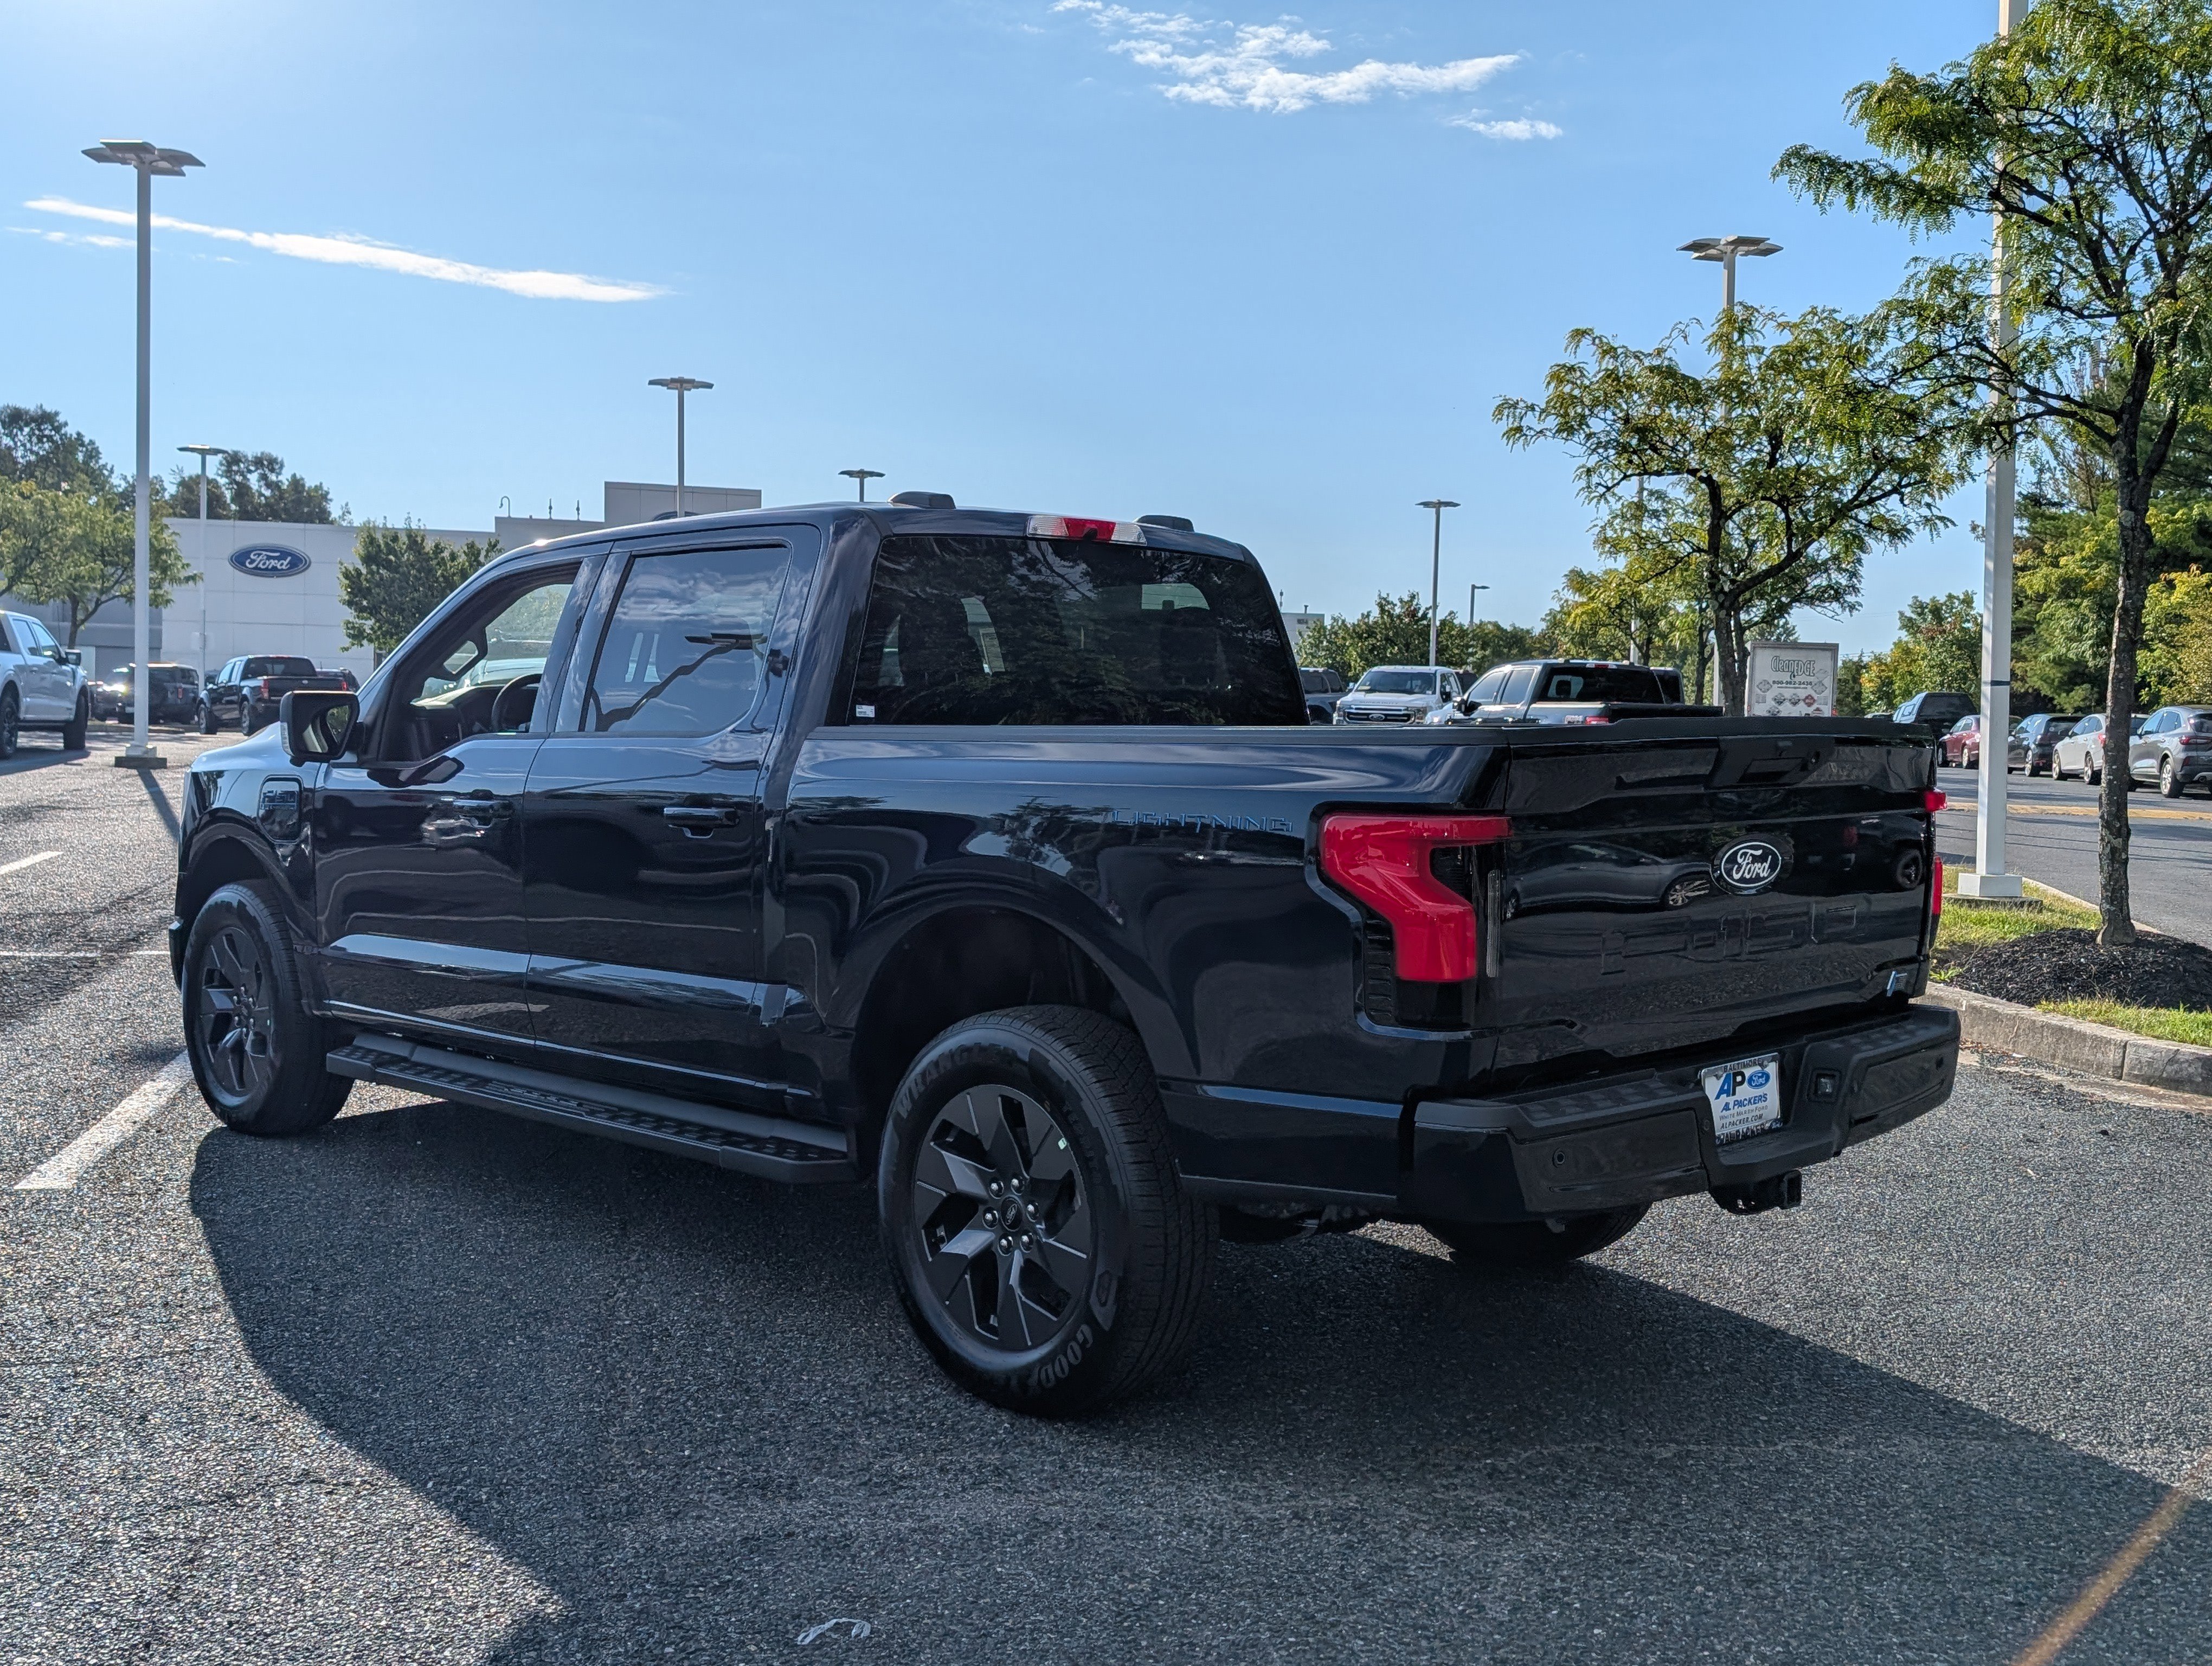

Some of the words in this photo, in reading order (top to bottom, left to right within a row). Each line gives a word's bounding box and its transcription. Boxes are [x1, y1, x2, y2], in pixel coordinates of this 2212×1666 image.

[246, 550, 292, 569] Ford
[1113, 810, 1294, 834] LIGHTNING
[1733, 849, 1772, 880] Ford
[1723, 1058, 1763, 1073] BALTIMORE
[1714, 1071, 1746, 1100] AP
[1751, 1073, 1766, 1086] Ford
[1721, 1101, 1731, 1113] AL
[1733, 1092, 1768, 1109] PACKER'S
[1720, 1113, 1764, 1130] ALPACKER.COM
